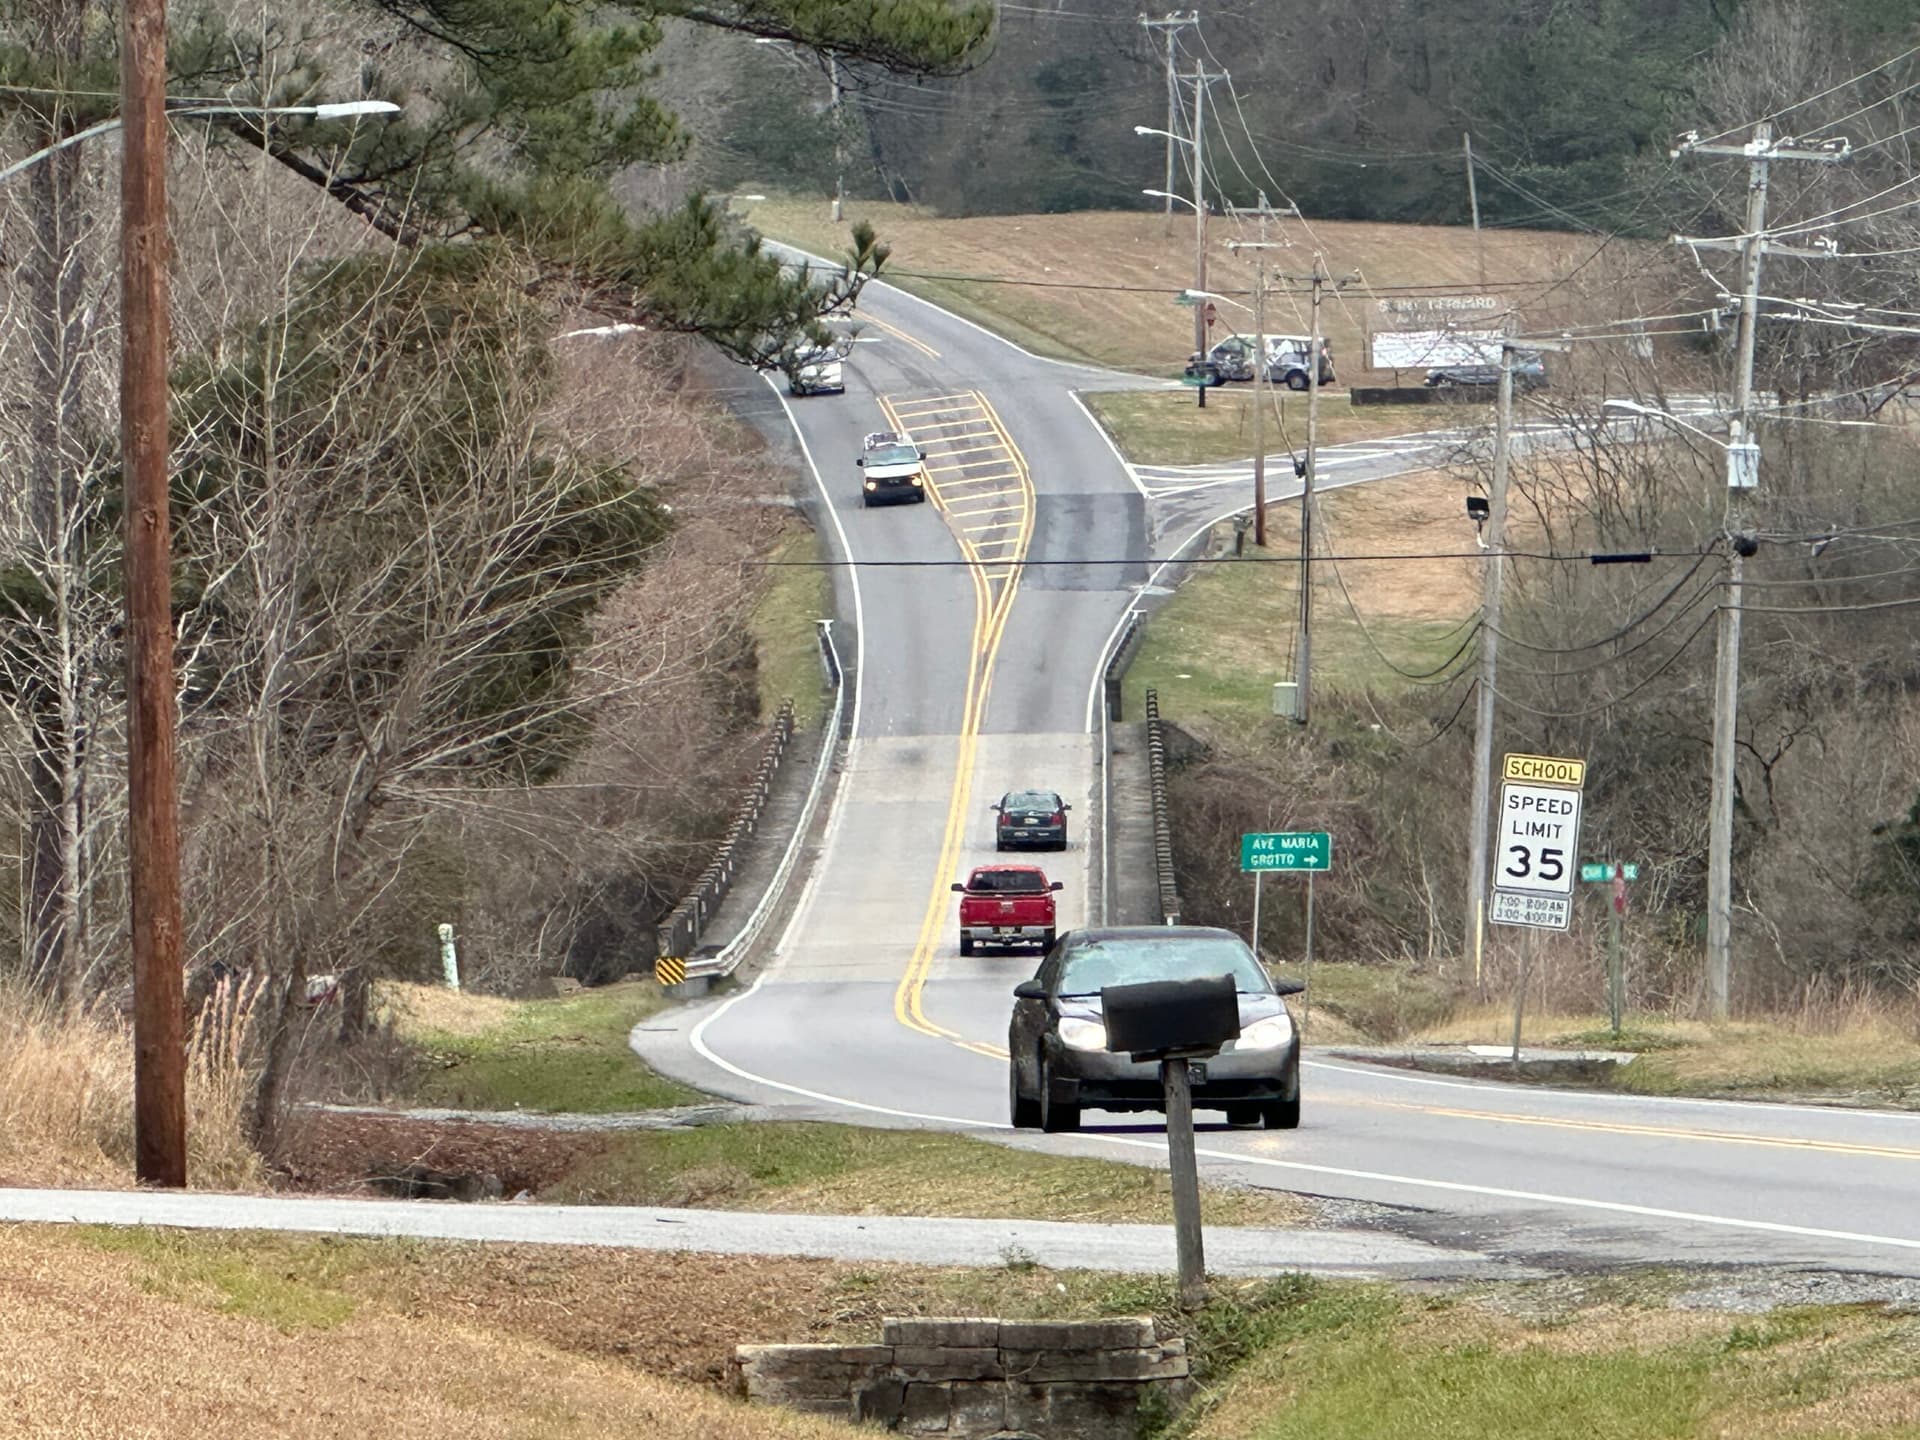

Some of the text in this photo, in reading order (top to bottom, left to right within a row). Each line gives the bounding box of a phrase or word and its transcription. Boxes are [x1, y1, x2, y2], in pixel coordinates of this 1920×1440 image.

[1510, 760, 1578, 781] SCHOOL
[1508, 794, 1573, 815] SPEED
[1512, 820, 1562, 839] LIMIT
[1252, 837, 1319, 850] AVE MARIA
[1250, 852, 1295, 866] GROTTO
[1505, 845, 1564, 881] 35
